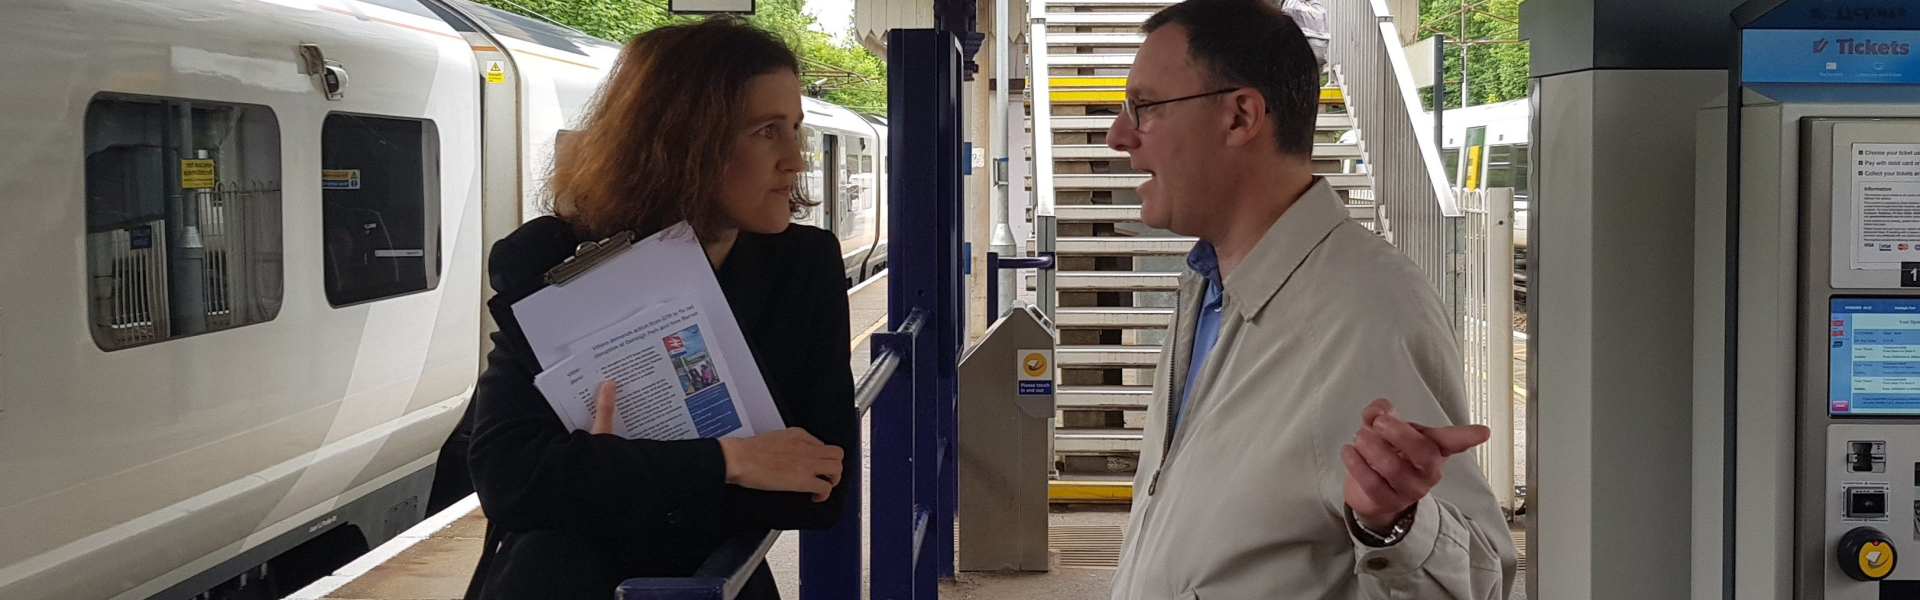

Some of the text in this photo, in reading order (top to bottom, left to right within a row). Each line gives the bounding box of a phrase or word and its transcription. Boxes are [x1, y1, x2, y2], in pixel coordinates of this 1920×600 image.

[1836, 38, 1910, 55] Tickets
[1910, 268, 1917, 282] 1
[610, 330, 633, 343] demands
[634, 324, 649, 334] action
[662, 313, 672, 321] GTR
